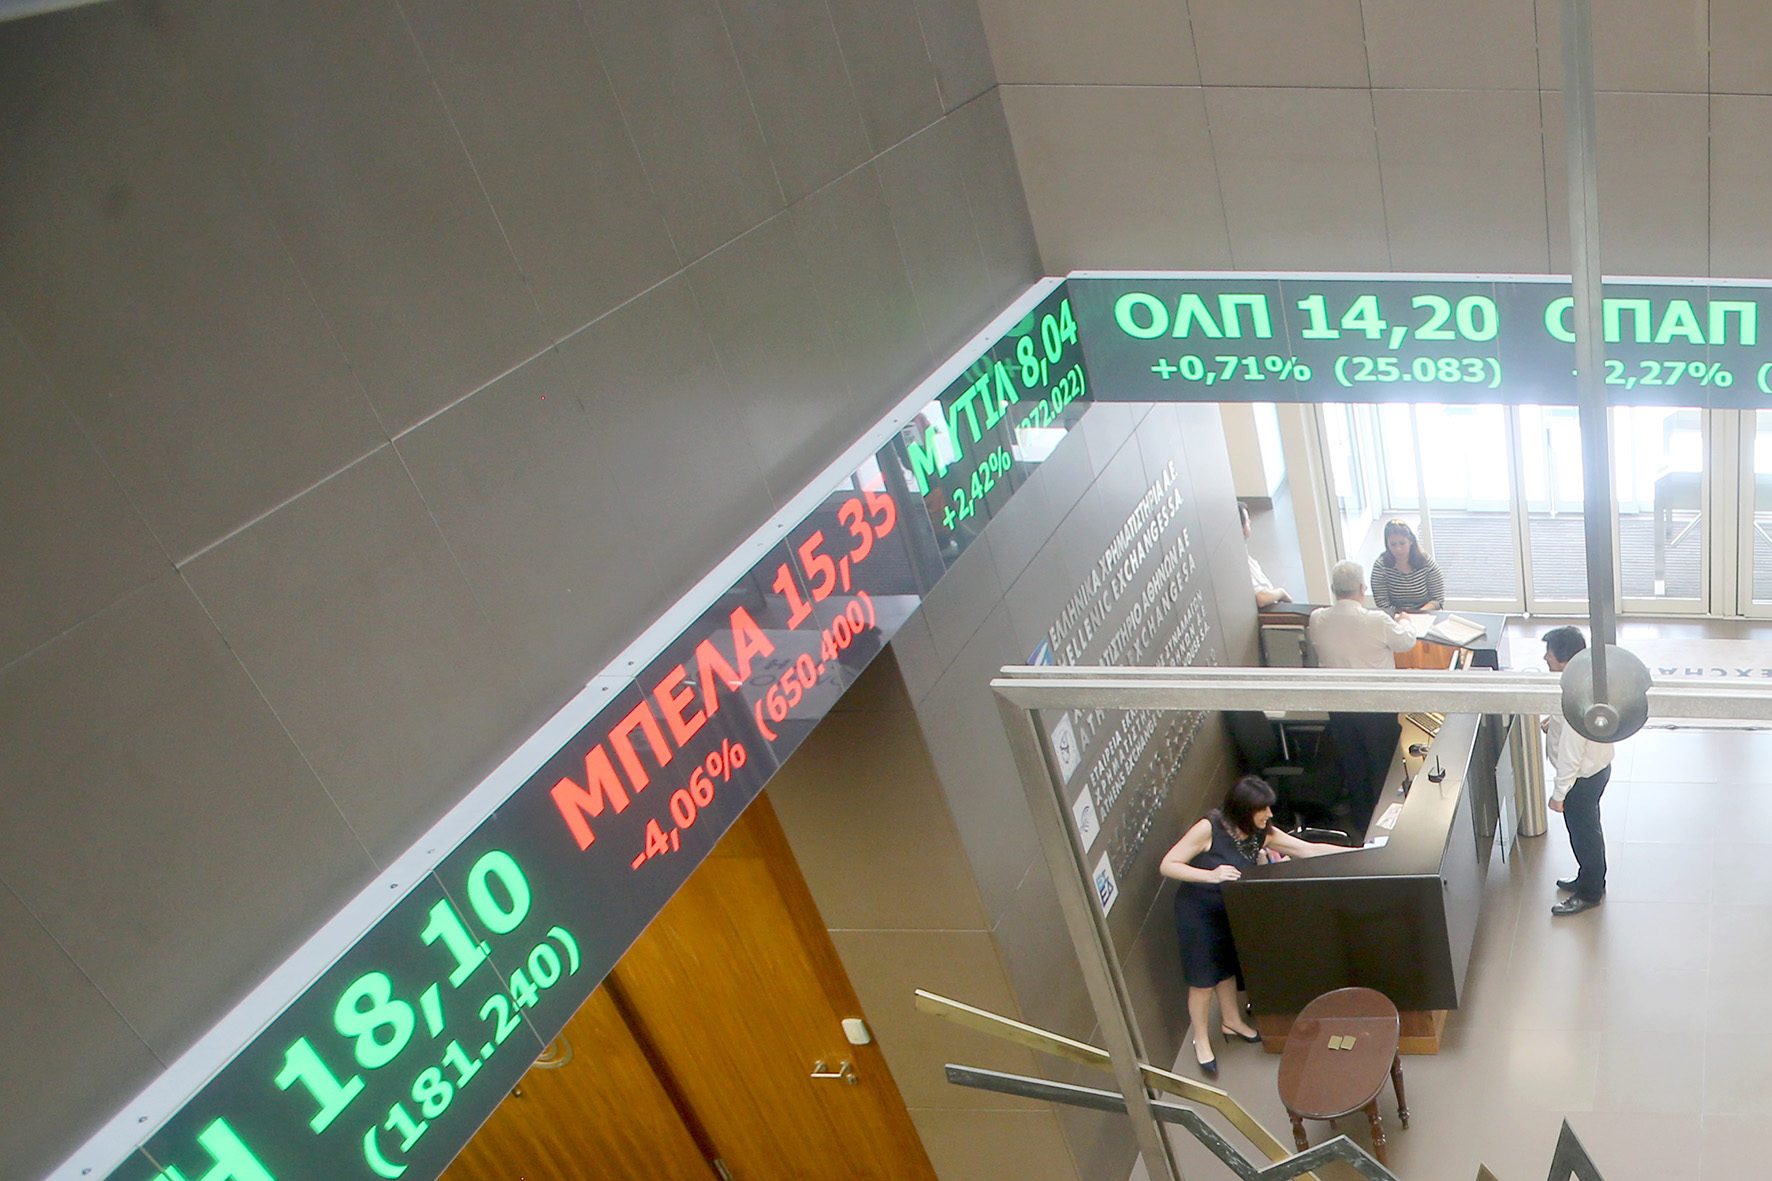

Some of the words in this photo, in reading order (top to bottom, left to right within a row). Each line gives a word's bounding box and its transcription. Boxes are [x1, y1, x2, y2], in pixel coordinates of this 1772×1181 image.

[1014, 298, 1079, 389] 8,04
[1113, 291, 1273, 340] ΟΛΠ
[1296, 294, 1501, 349] 14,20
[1150, 354, 1313, 385] +0,71%
[1334, 354, 1504, 389] (25.083)
[941, 445, 1013, 531] +2,42%
[1049, 569, 1102, 652] ΕΛΛΗΝΙΚΑ
[1057, 590, 1113, 666] HELLENIC
[1110, 504, 1169, 601] EXCHANGES
[549, 606, 776, 852] ΜΠΕΛΑ
[772, 474, 898, 632] 15,35
[630, 738, 748, 871] -4,06%
[754, 590, 877, 742] (650.400)
[1090, 729, 1123, 788] ΕΤΑΙΡΕΙΑ
[1101, 771, 1127, 823] ATHENS
[1124, 716, 1158, 777] EXCHANGE
[273, 848, 533, 1136] 18,10
[361, 925, 582, 1180] (181.240)
